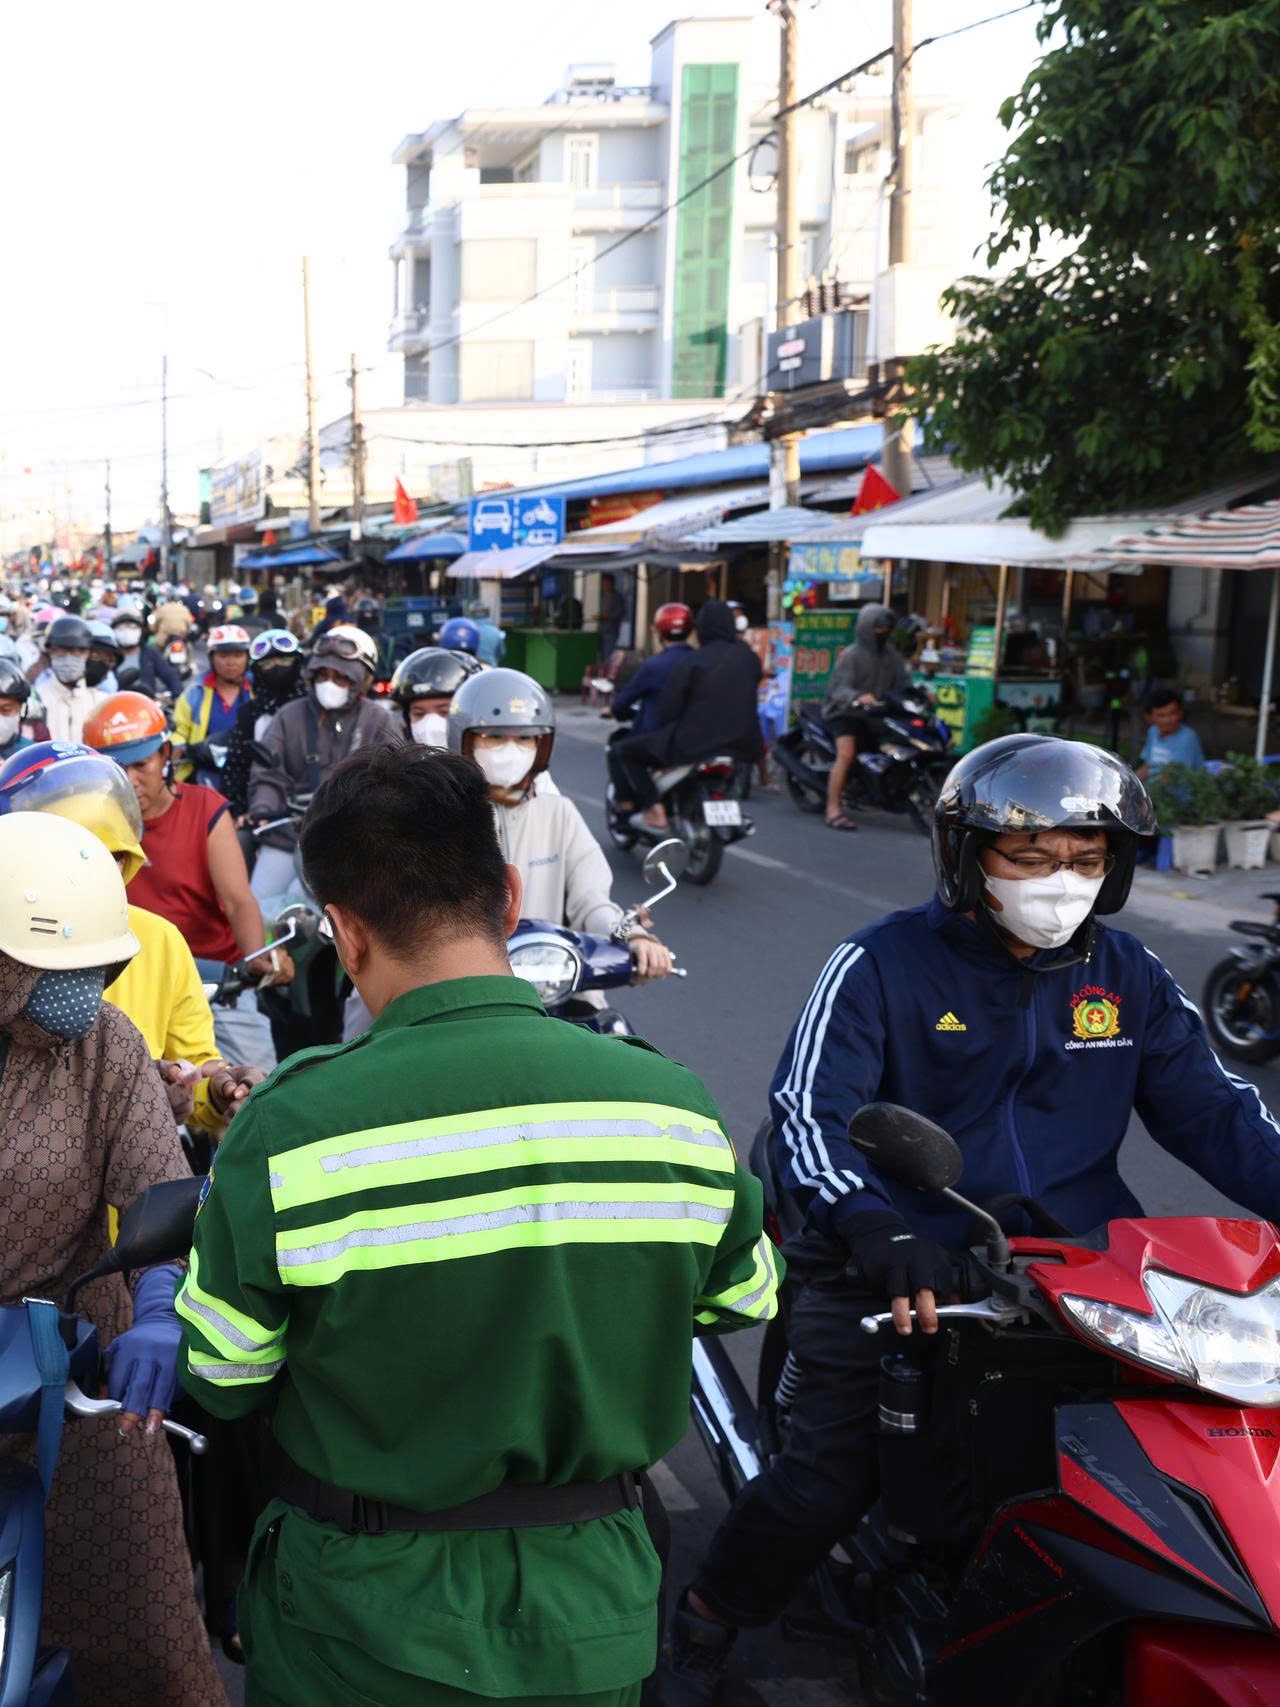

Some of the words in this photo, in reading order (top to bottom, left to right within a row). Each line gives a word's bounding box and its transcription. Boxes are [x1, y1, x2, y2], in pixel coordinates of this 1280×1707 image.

[1079, 984, 1107, 997] CÔNG
[936, 1022, 967, 1032] adidas
[1065, 1039, 1085, 1051] CÔNG
[1085, 1040, 1096, 1049] AN
[1207, 1426, 1276, 1439] HONDA
[1060, 1435, 1168, 1529] BLADE
